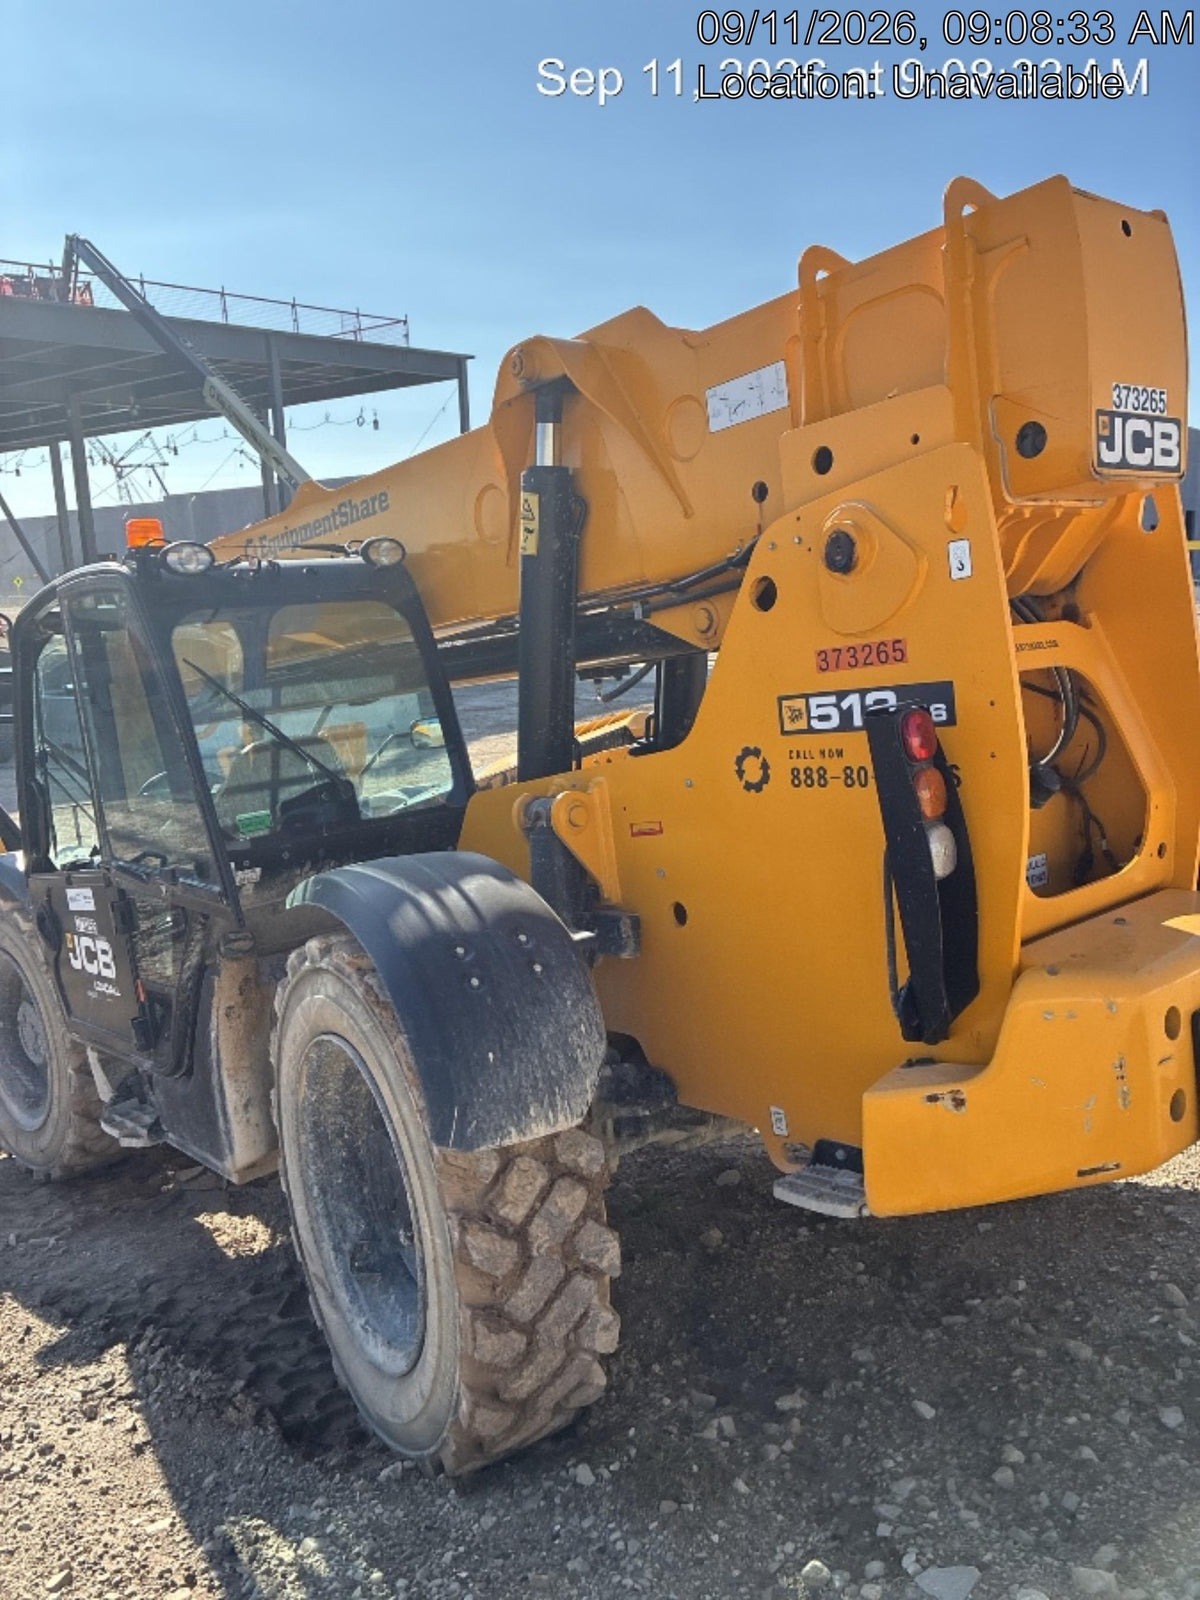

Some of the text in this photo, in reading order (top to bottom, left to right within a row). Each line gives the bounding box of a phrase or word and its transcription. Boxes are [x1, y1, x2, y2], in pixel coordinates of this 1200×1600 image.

[1112, 383, 1166, 414] 373265
[1099, 417, 1180, 467] JCB
[817, 640, 906, 672] 373265
[788, 747, 844, 760] CALL NOW
[69, 934, 116, 979] JCB
